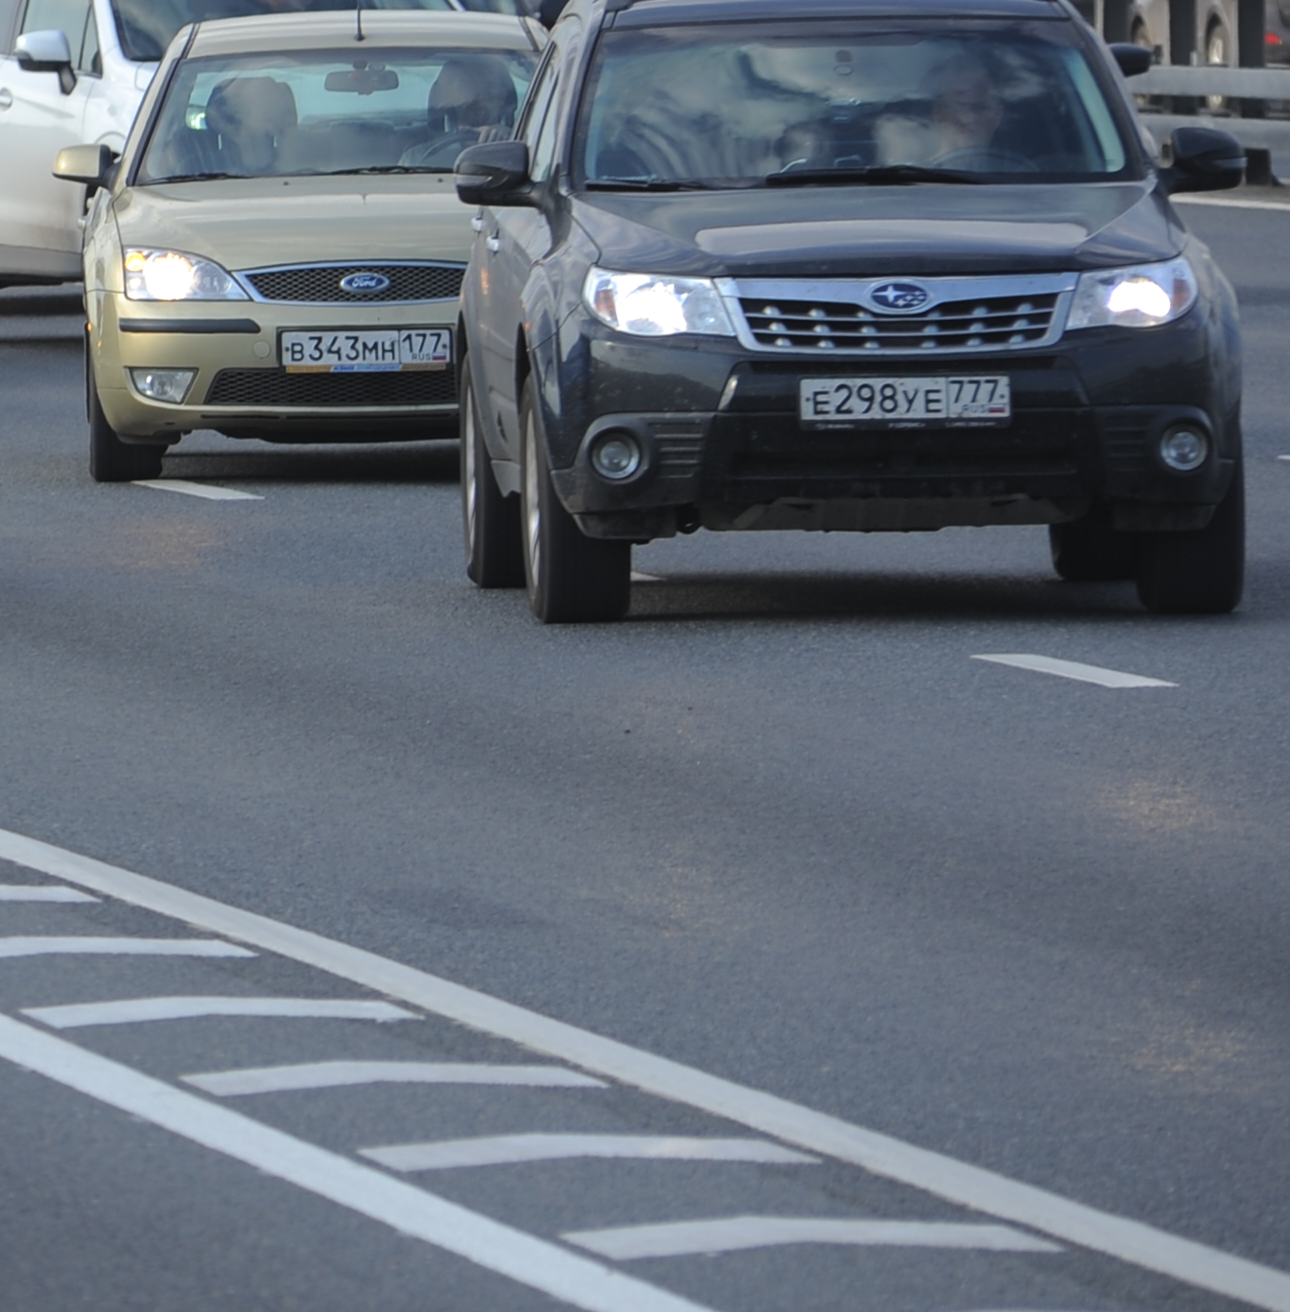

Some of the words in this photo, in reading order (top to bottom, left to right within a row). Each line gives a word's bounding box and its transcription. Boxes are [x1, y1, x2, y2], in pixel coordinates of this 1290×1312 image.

[351, 276, 378, 287] Ford
[290, 336, 397, 362] В343МН
[402, 333, 443, 354] 177
[411, 352, 432, 362] RUS
[812, 383, 943, 416] Е298УЕ
[949, 379, 1000, 404] 777
